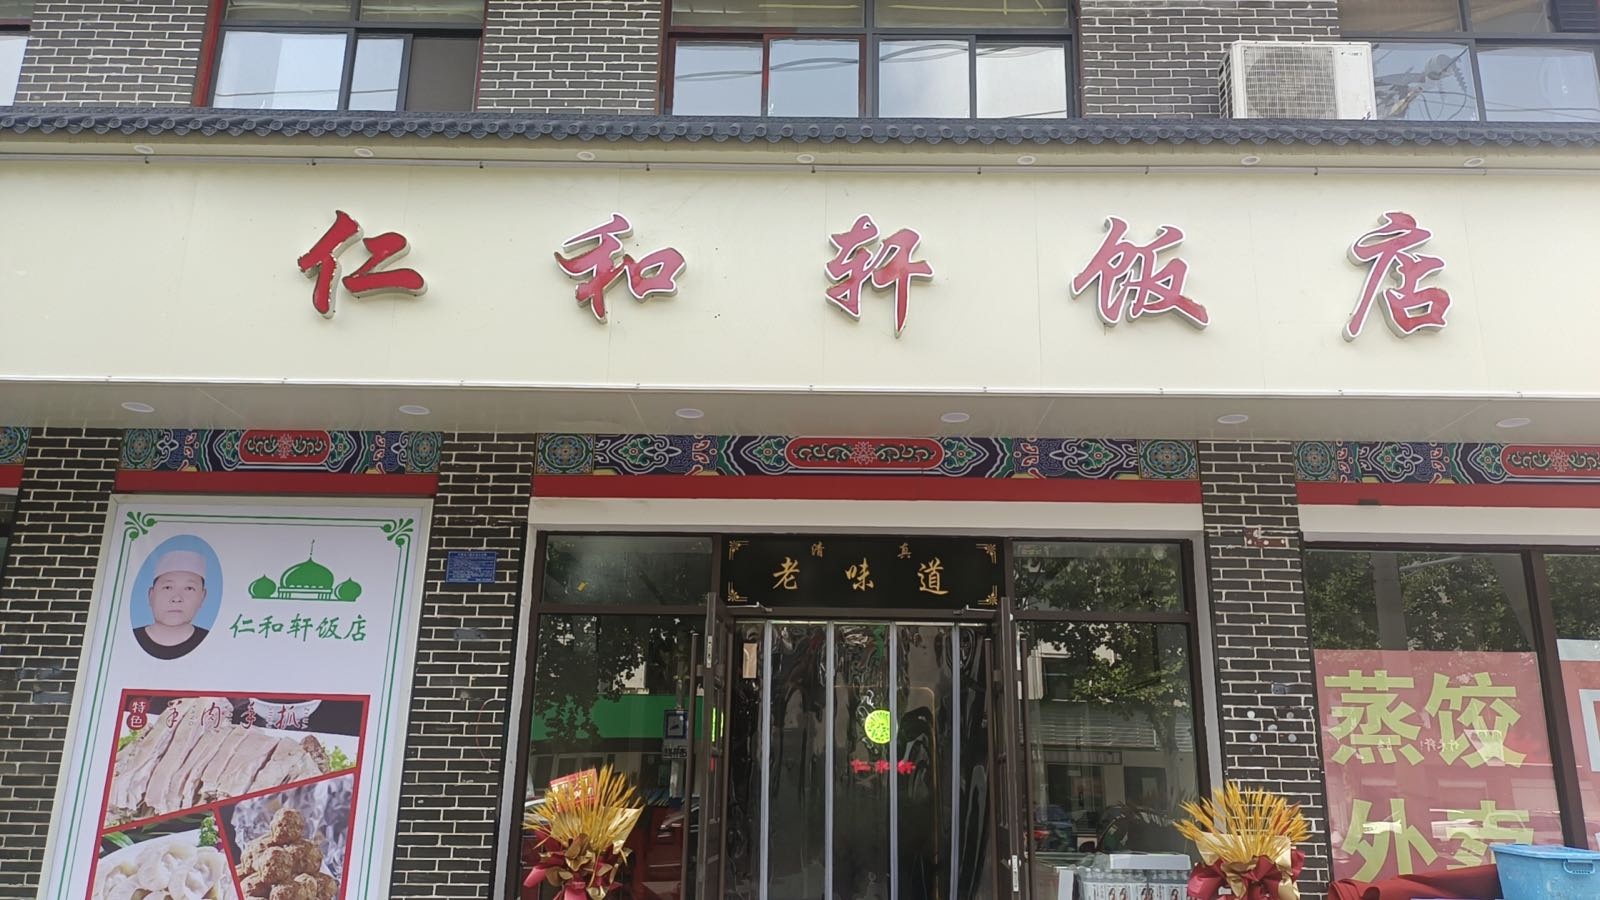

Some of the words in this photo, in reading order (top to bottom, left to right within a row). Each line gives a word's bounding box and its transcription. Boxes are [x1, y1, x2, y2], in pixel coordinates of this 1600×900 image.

[297, 209, 1453, 342] 仁和轩饭店
[811, 541, 912, 559] 清真
[772, 556, 949, 595] 老味道
[229, 613, 367, 642] 仁和轩饭店
[131, 701, 147, 728] 特色
[1323, 669, 1527, 769] 蒸饺
